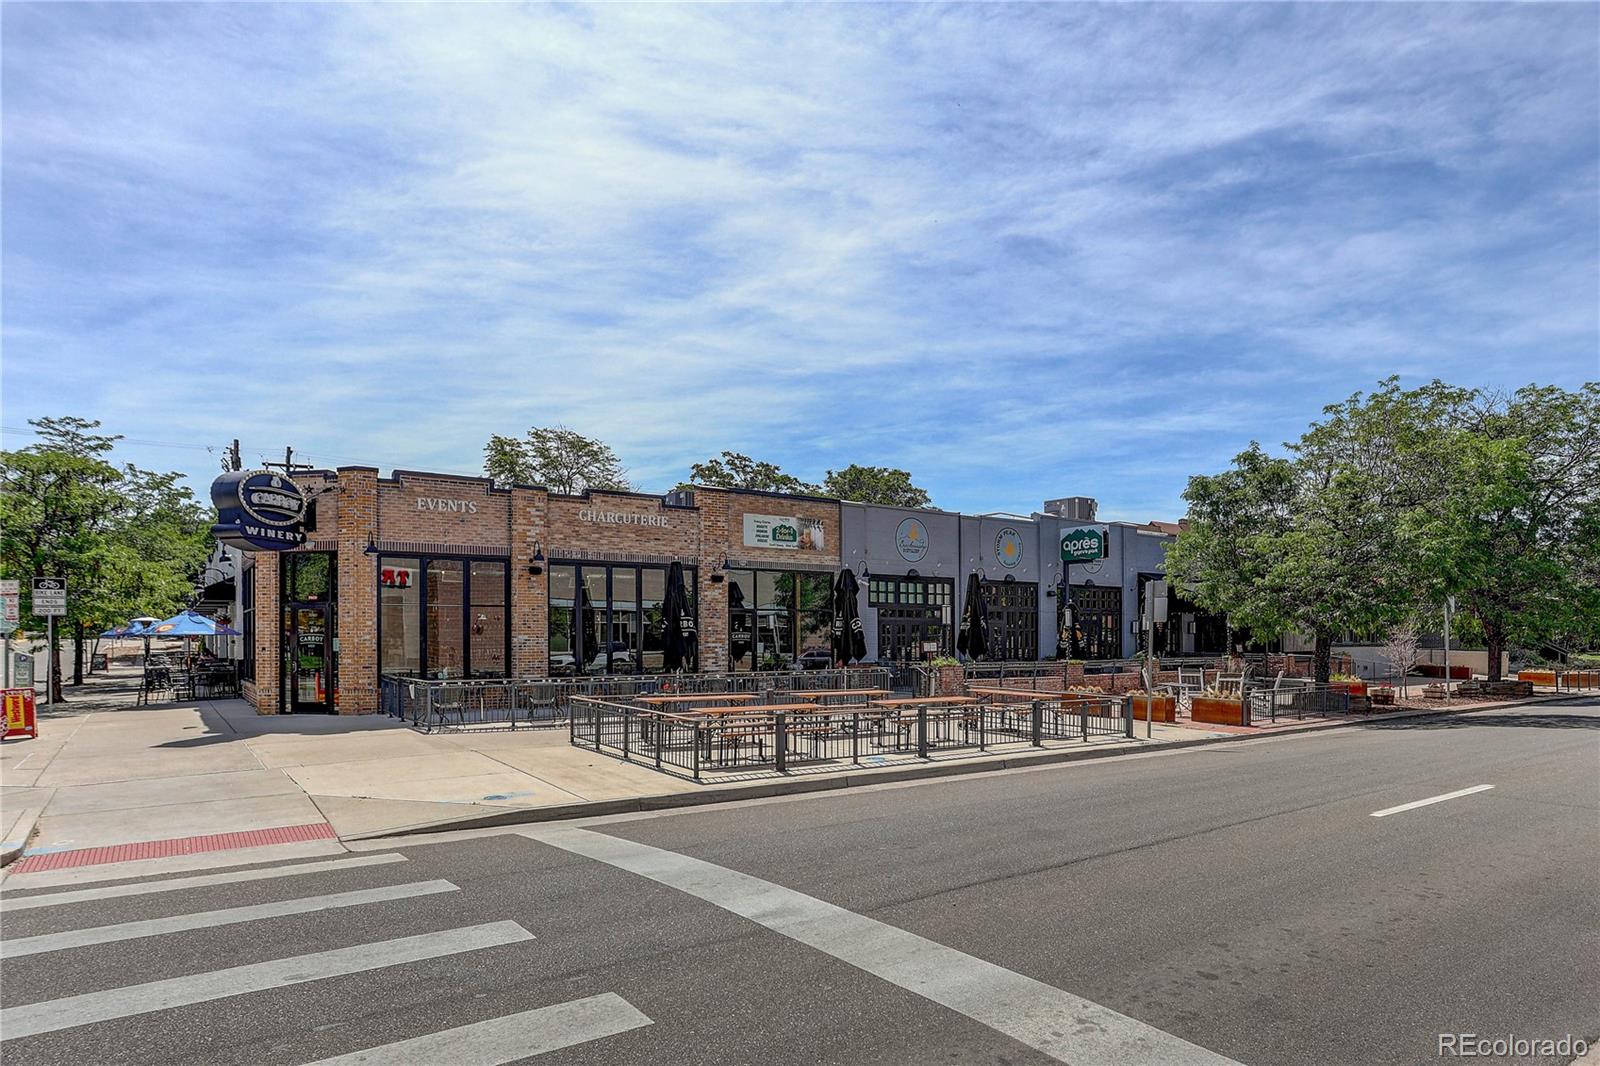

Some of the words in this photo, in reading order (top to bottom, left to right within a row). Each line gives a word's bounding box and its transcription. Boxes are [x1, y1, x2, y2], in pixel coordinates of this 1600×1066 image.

[417, 497, 478, 514] EVENTS
[579, 509, 669, 528] CHARCUTERIE
[245, 525, 303, 542] WINERY
[1063, 536, 1099, 554] après
